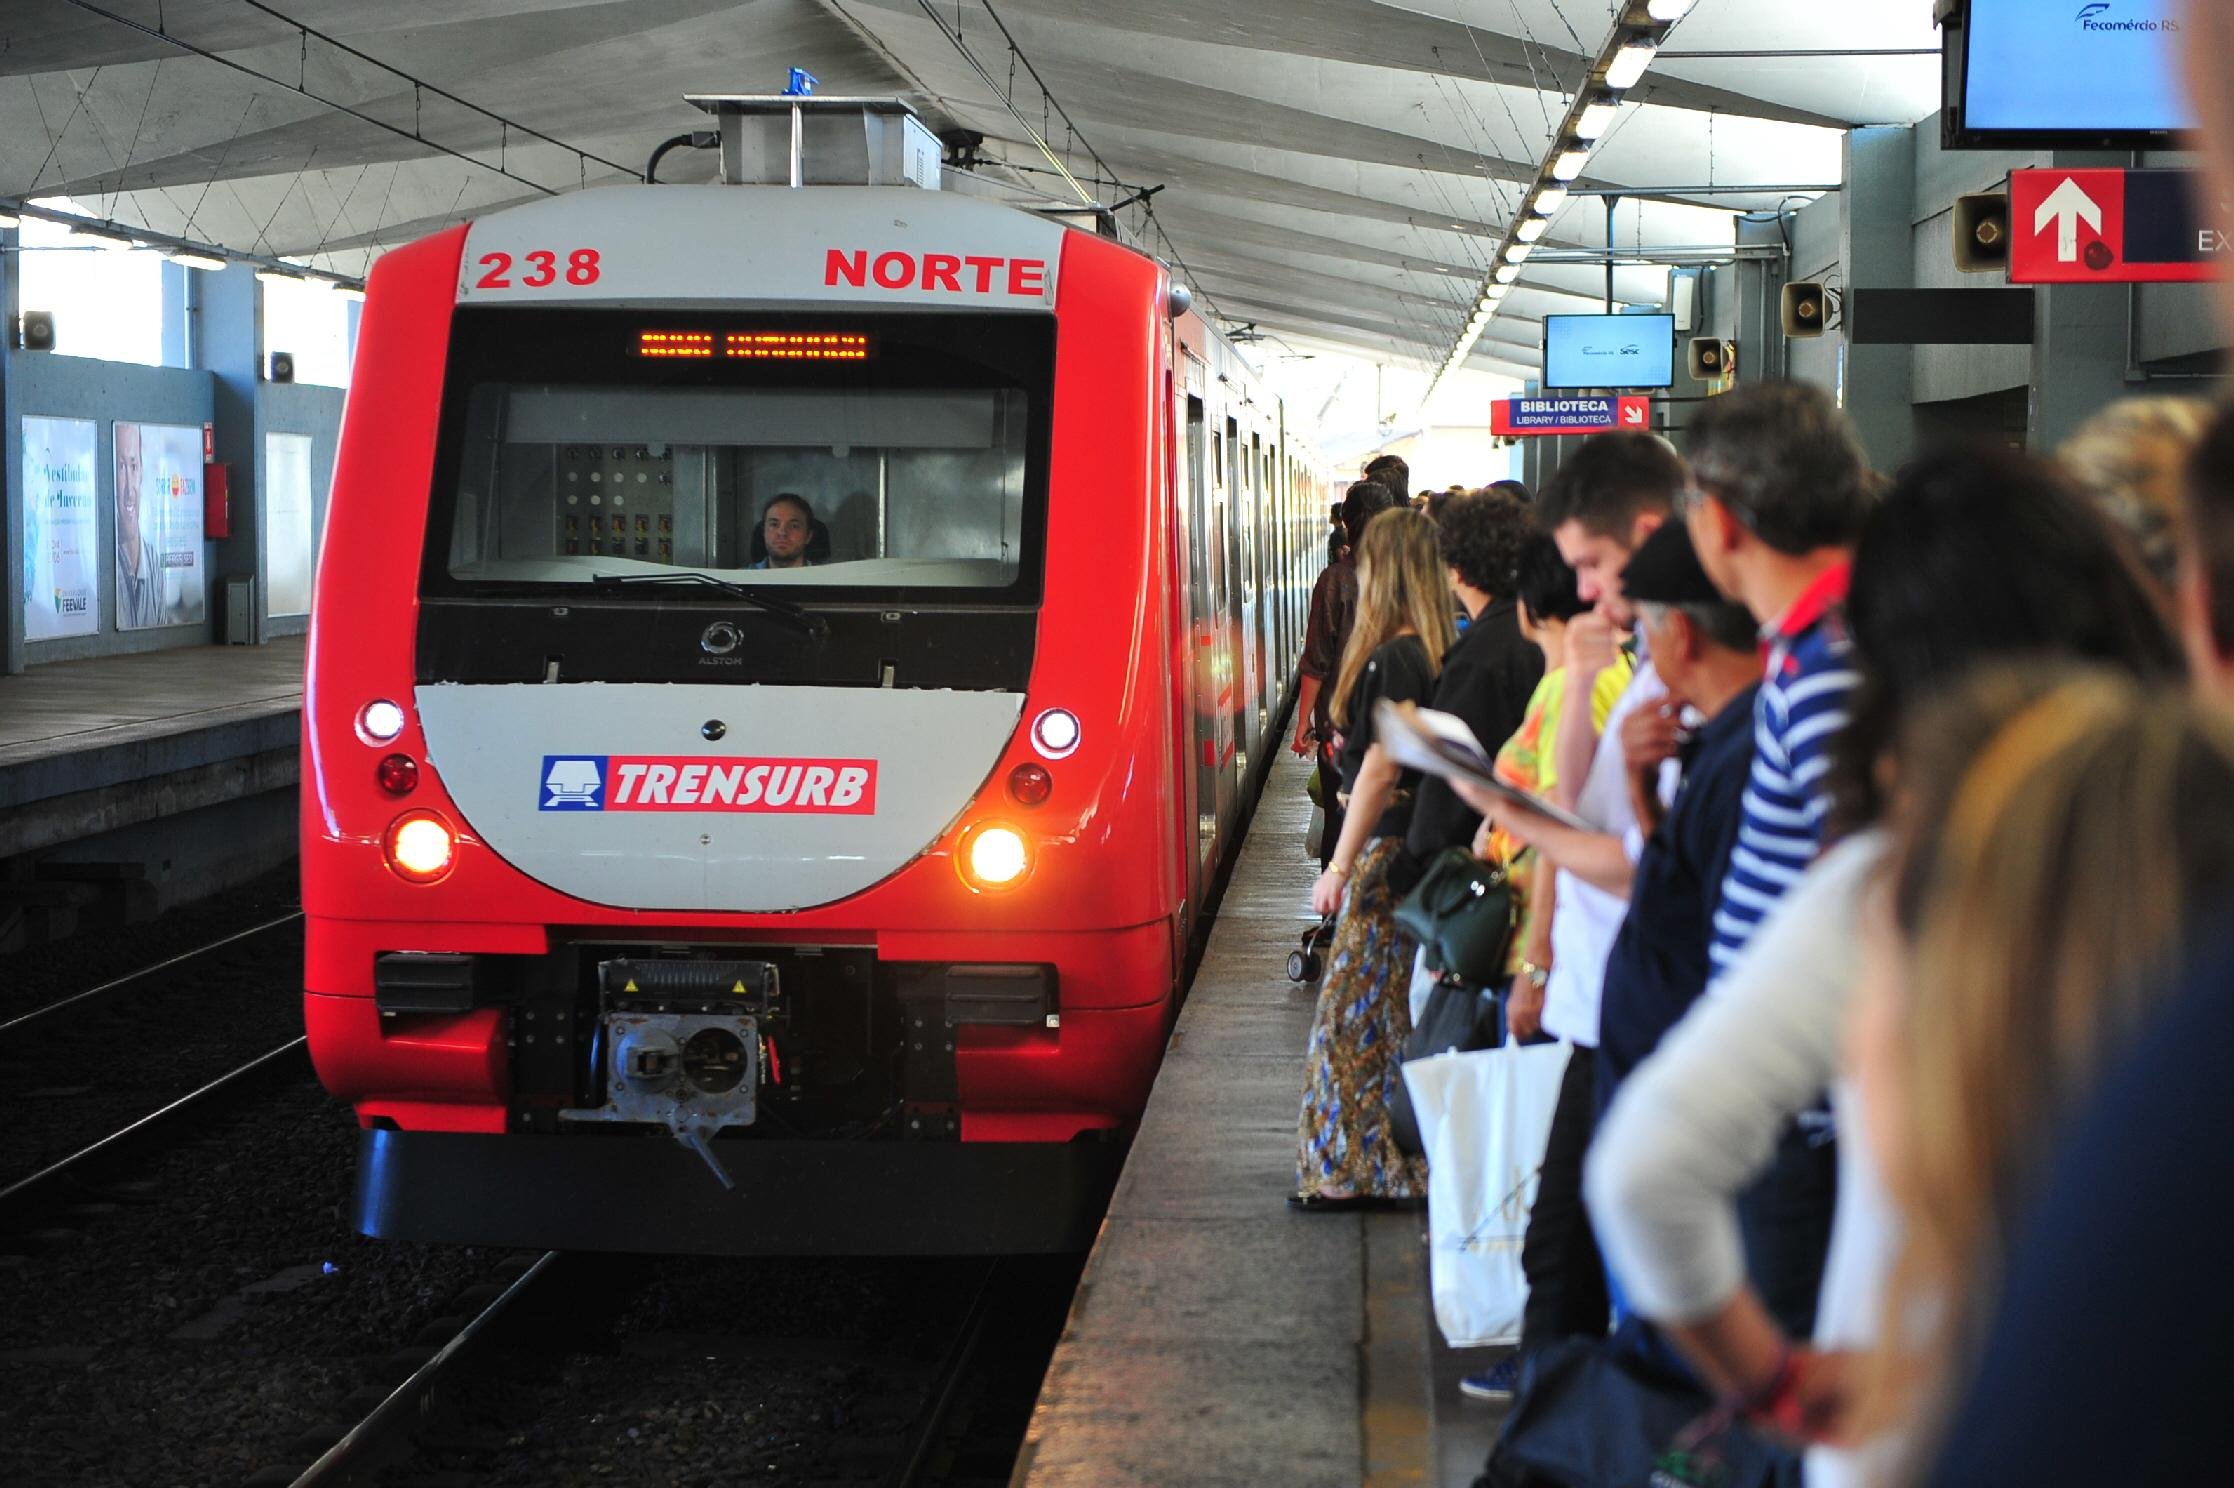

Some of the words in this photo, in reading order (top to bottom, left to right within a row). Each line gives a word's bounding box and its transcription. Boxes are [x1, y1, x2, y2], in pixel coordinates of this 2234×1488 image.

[2083, 19, 2157, 31] Fecomércio
[2161, 20, 2178, 31] RS
[475, 248, 601, 289] 238
[824, 249, 1045, 296] NORTE
[1520, 400, 1608, 413] BIBLIOTECA
[1516, 416, 1553, 425] LIBRARY
[1560, 415, 1611, 424] BIBLIOTECA
[62, 598, 87, 613] FEEVALE
[698, 656, 742, 665] ALSTOM
[613, 763, 869, 807] TRENSURB
